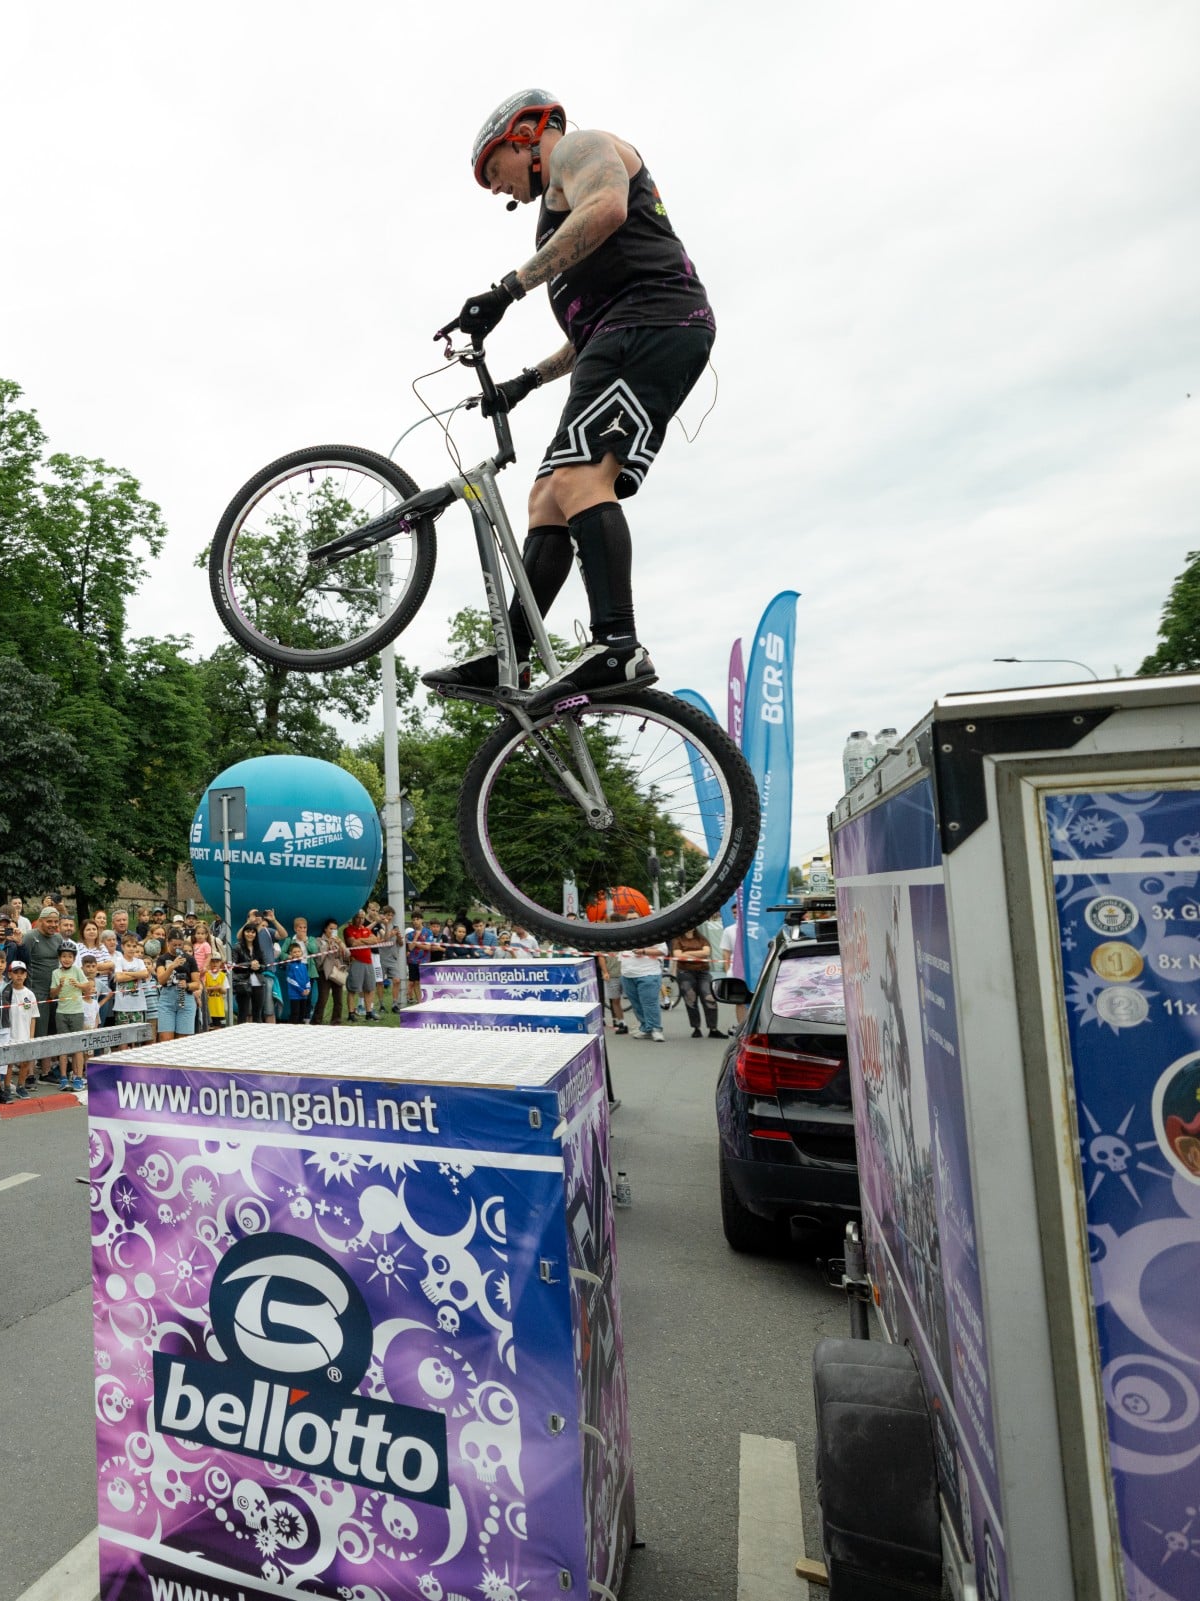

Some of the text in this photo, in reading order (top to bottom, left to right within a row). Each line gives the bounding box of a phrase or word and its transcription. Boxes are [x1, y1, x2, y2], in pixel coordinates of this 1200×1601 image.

[218, 569, 230, 609] KENDA
[761, 665, 784, 725] BCR
[301, 811, 342, 823] SPORT
[262, 821, 342, 843] ARENA
[284, 833, 343, 852] STREETBALL
[269, 853, 367, 870] STREETBALL
[1151, 904, 1175, 920] 3x
[1159, 954, 1182, 969] 8x
[435, 968, 549, 984] www.orbangabi.net
[1163, 999, 1198, 1015] 11x
[116, 1080, 440, 1134] www.orbangabi.net
[161, 1363, 438, 1493] bellotto
